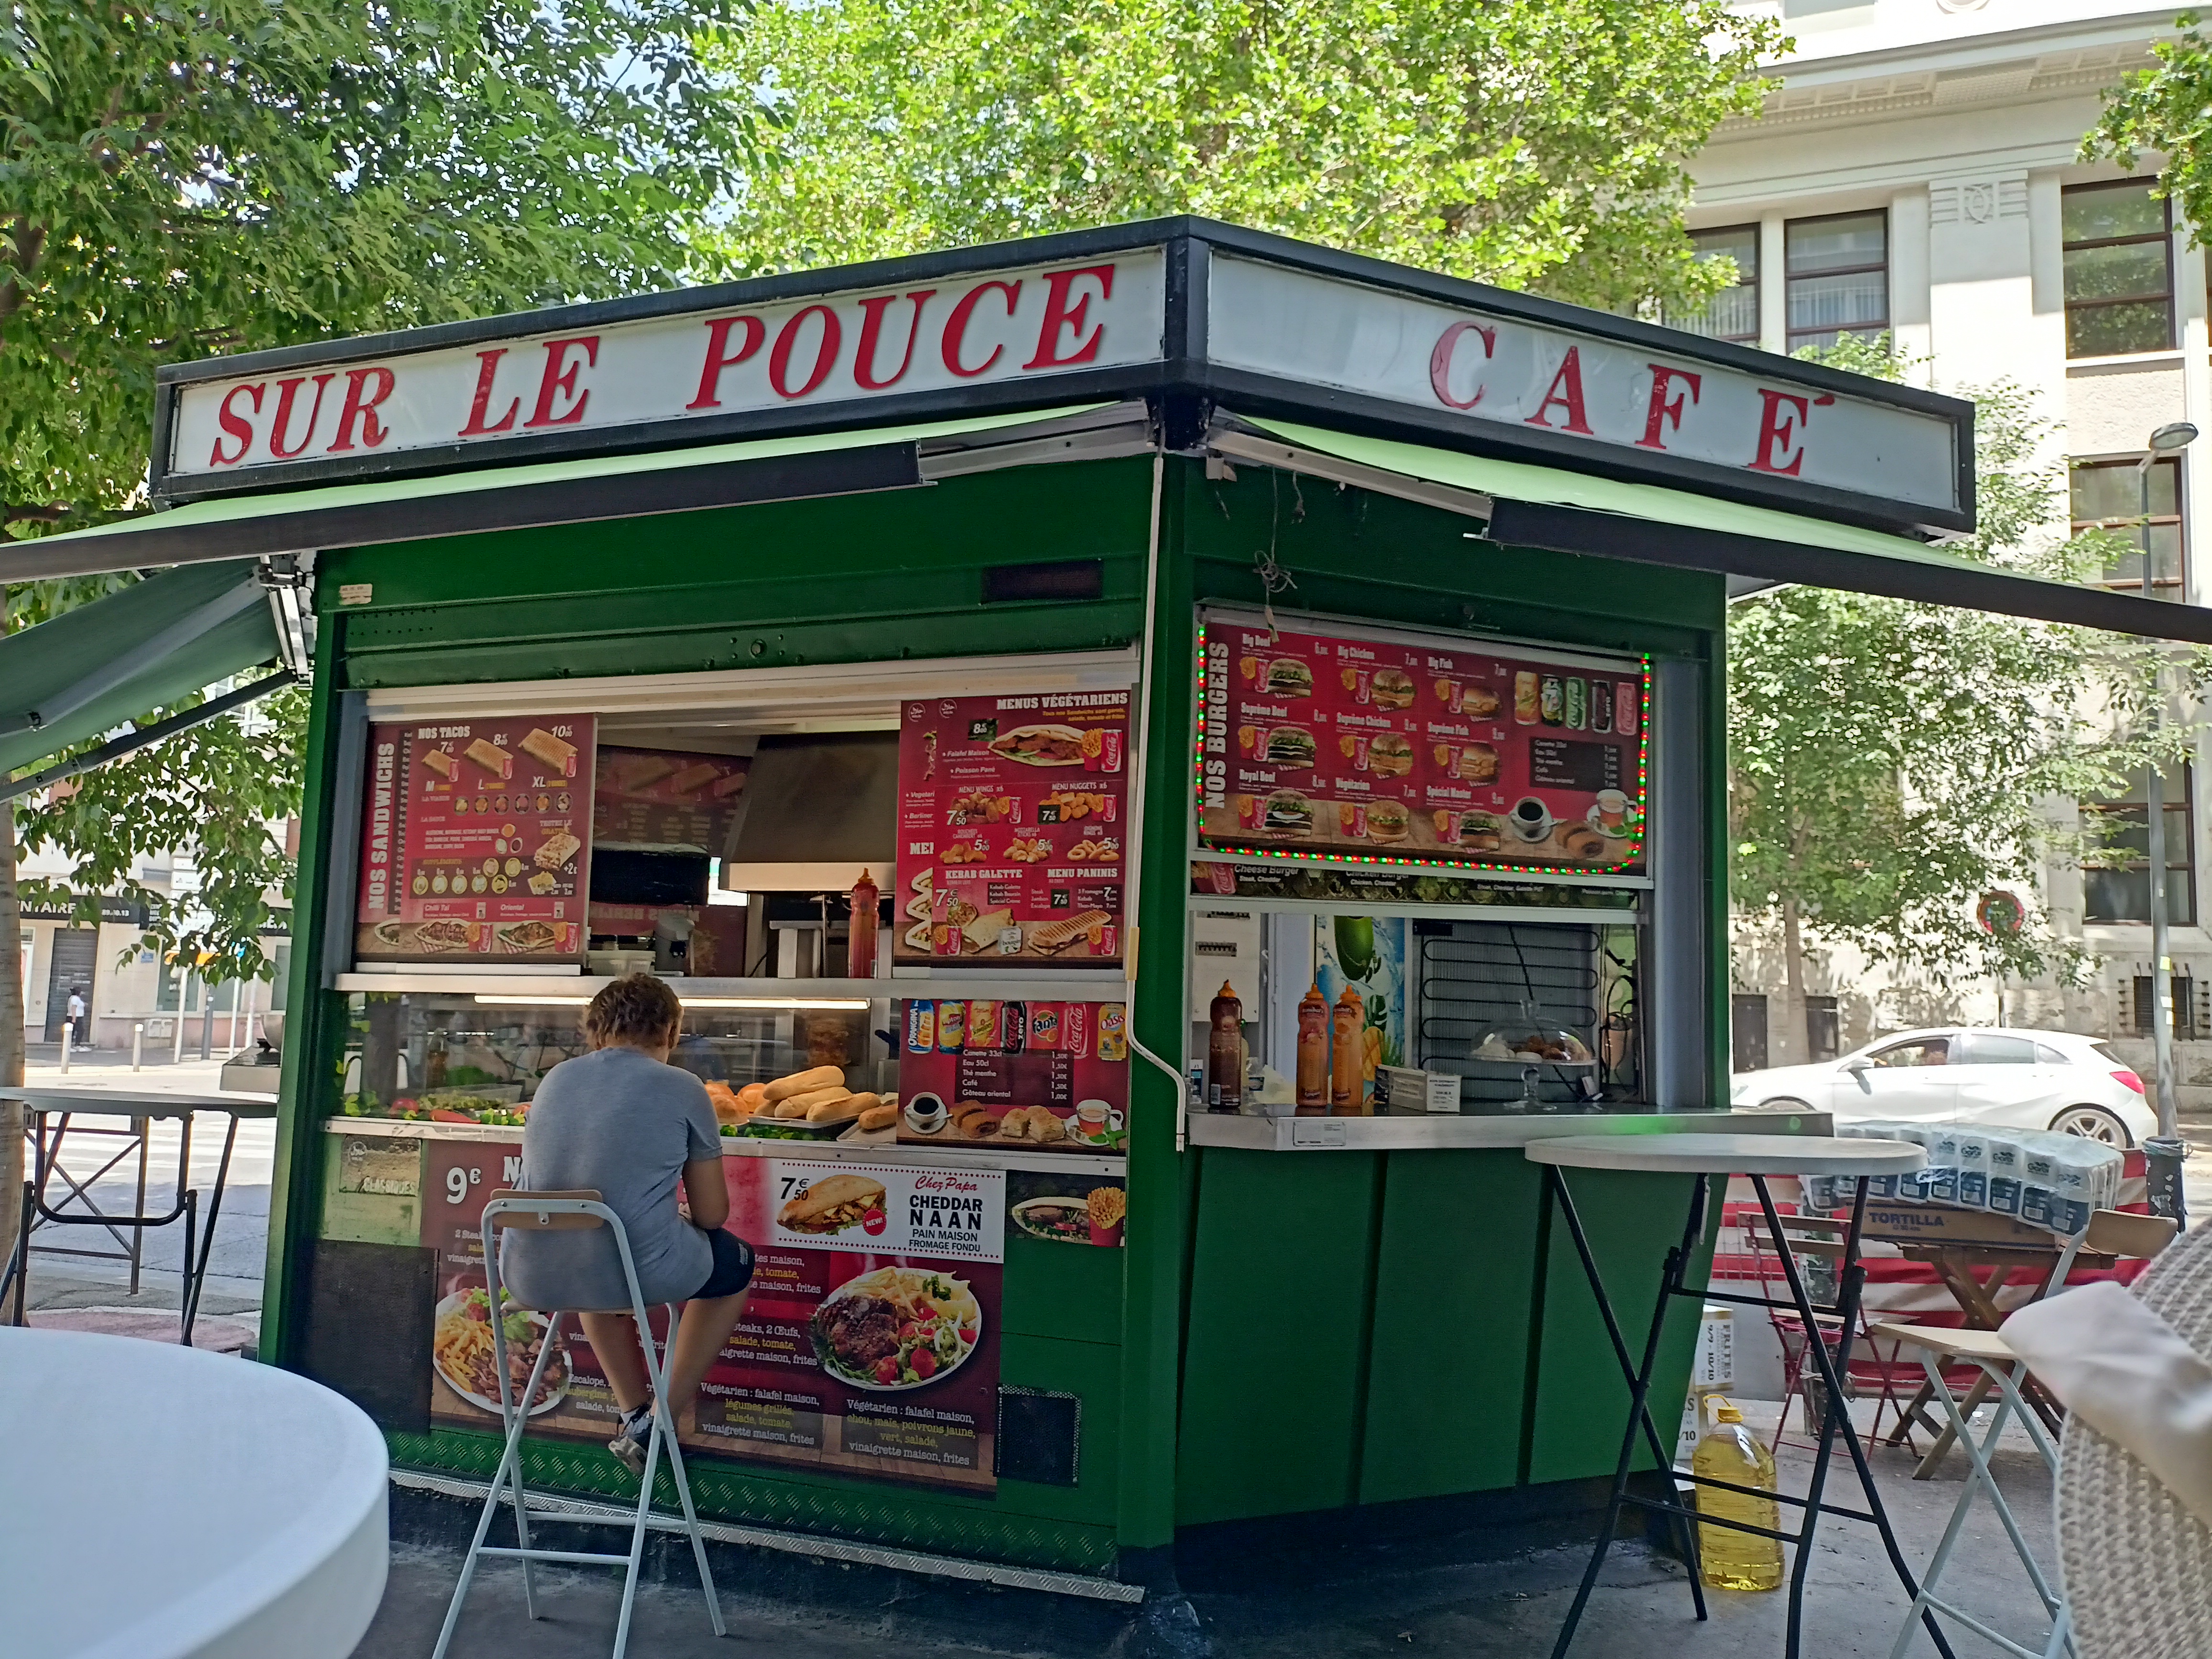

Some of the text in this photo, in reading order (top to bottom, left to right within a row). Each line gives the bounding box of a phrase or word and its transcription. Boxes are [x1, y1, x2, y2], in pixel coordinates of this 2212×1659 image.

[210, 264, 1115, 467] SUR LE POUCE
[997, 693, 1128, 710] MENUS VÉGÉTARIENS
[418, 726, 470, 739] NOS TACOS
[1206, 641, 1229, 809] NOS BURGERS
[532, 776, 546, 788] XL
[368, 742, 395, 909] NOS SANDWICHS
[946, 869, 1023, 879] KEBAB GALETTE
[1047, 868, 1118, 878] MENU PANINIS
[1235, 864, 1299, 876] Cheese Burger
[908, 1008, 918, 1046] ORANGINA
[916, 1175, 978, 1193] Chez Papa
[909, 1195, 983, 1212] CHEDDAR
[865, 1217, 883, 1228] NEW!
[1869, 1212, 1945, 1227] TORTILLA
[912, 1229, 978, 1242] PAIN MAISON
[909, 1239, 980, 1252] FROMAGE FONDU
[770, 1256, 805, 1267] maison,
[765, 1267, 799, 1280] tomate,
[760, 1281, 821, 1294] maison, frites
[766, 1325, 772, 1334] 2
[729, 1335, 796, 1351] salade, tomate,
[756, 1352, 791, 1364] maison,
[793, 1354, 818, 1366] frites
[1723, 1325, 1731, 1378] FRITES
[700, 1382, 819, 1406] Végétarien falafel maison,
[576, 1401, 605, 1413] salade,
[725, 1398, 762, 1411] légumes
[847, 1399, 974, 1424] Végétarien falafel maison,
[702, 1423, 814, 1445] vinaigrette maison, frites
[902, 1421, 944, 1434] poivrons
[946, 1425, 976, 1439] jaune,
[880, 1432, 938, 1448] vert, salade,
[849, 1441, 969, 1465] vinaigrette maison, frites
